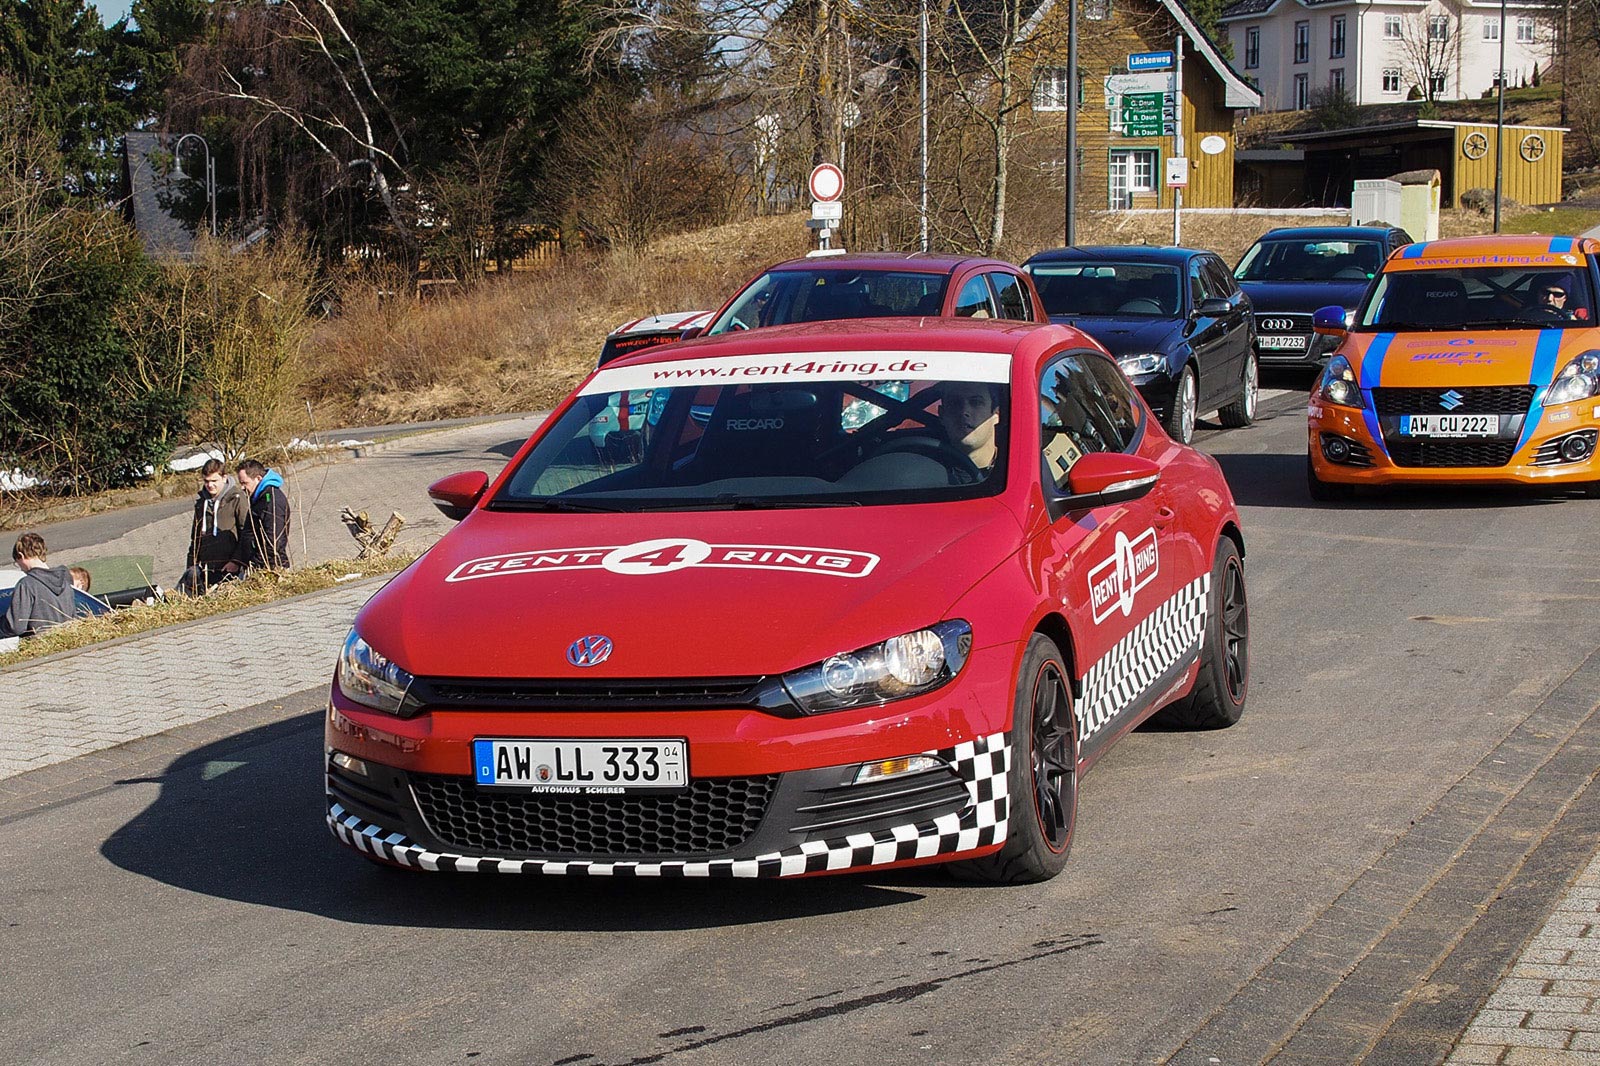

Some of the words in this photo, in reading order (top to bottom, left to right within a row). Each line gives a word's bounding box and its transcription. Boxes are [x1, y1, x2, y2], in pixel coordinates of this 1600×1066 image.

[1415, 254, 1555, 266] www.rent4ring.de
[1270, 337, 1280, 347] PA
[1283, 337, 1304, 347] 7232
[1410, 351, 1490, 362] SWIFT
[653, 359, 929, 379] www.rent4ring.de
[726, 418, 784, 430] RECARO
[1411, 417, 1429, 432] AW
[1439, 417, 1458, 432] CU
[1461, 417, 1488, 432] 222
[467, 552, 604, 574] RENT
[630, 544, 689, 567] 4
[722, 550, 853, 569] RING
[1093, 570, 1119, 608] RENT
[1122, 545, 1133, 598] 4
[1135, 543, 1155, 576] RING
[664, 746, 679, 757] 04
[496, 746, 531, 780] AW
[555, 747, 594, 781] LL
[602, 747, 660, 781] 333
[481, 766, 490, 776] D
[666, 770, 680, 781] 11
[531, 785, 581, 794] AUTOHAUS
[585, 786, 626, 794] SCHERER
